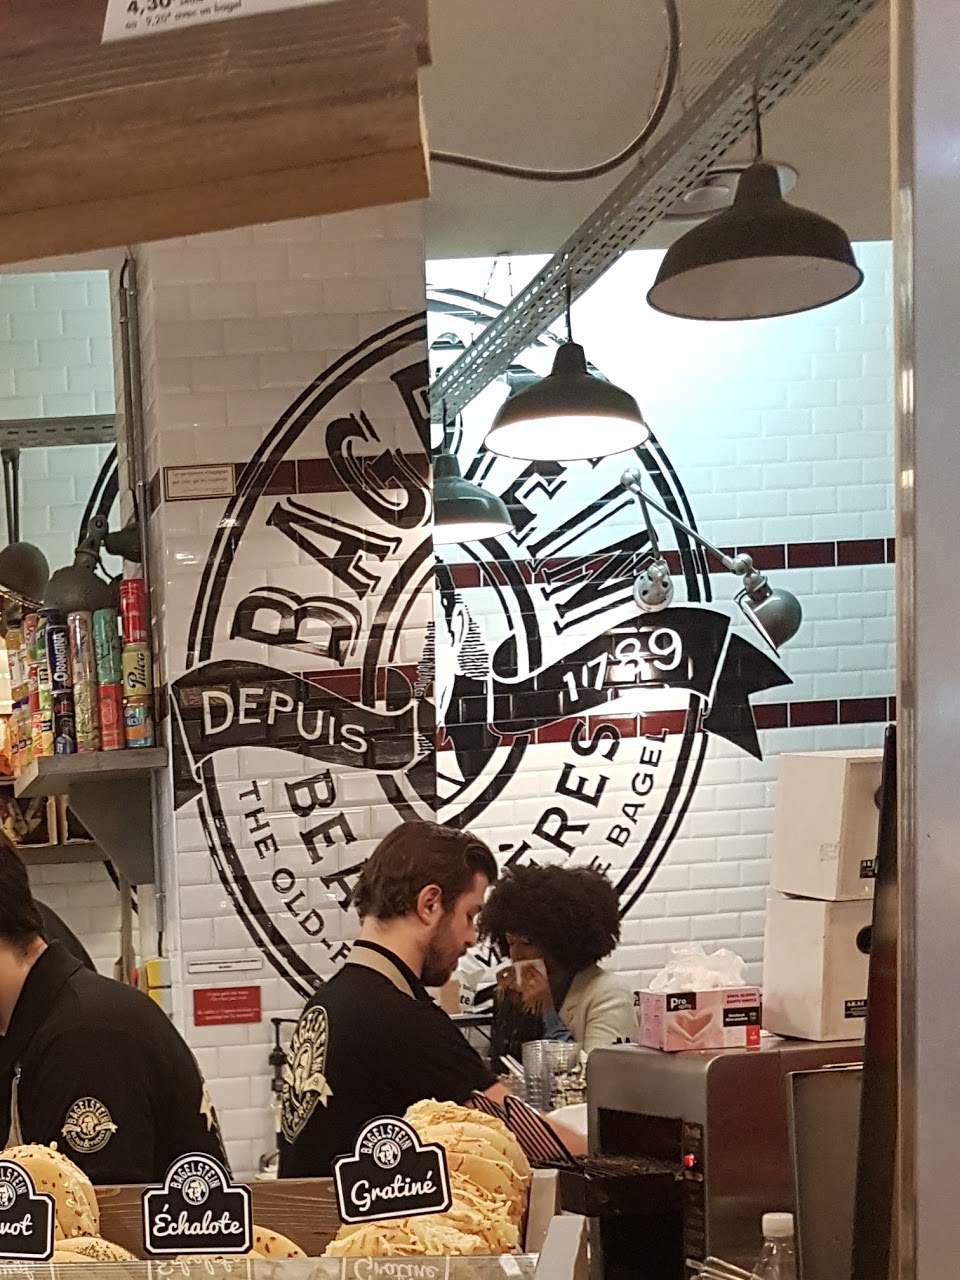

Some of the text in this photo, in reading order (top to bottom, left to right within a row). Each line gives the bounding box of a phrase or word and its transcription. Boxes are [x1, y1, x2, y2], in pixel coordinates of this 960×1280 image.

[52, 631, 68, 682] ORANGINA
[126, 652, 147, 689] Pulco
[562, 627, 683, 702] 1789
[202, 687, 369, 755] DEPUIS
[239, 728, 670, 964] THE OLD-F BAGEL
[284, 768, 369, 913] BEA
[67, 1099, 111, 1125] BAGELSTEIN
[360, 1124, 413, 1155] BAGELSTEIN
[170, 1161, 220, 1190] BAGELSTEIN
[350, 1171, 438, 1212] Gratiné
[152, 1203, 244, 1237] Échalote
